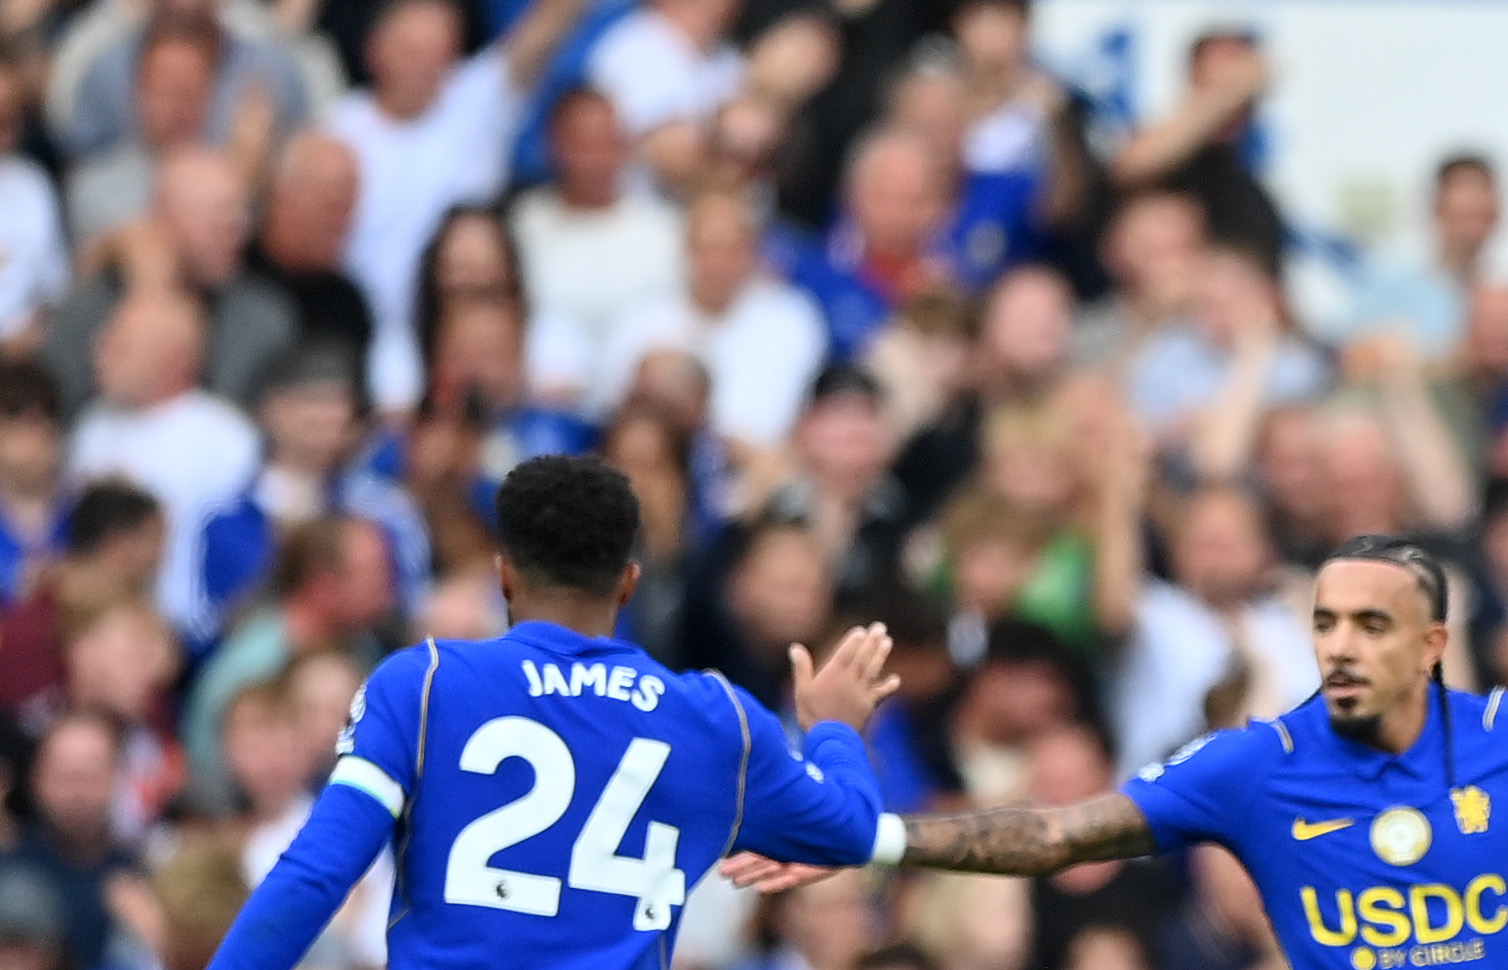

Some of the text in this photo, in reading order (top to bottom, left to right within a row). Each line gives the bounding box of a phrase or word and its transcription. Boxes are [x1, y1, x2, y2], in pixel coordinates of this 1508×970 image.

[521, 659, 665, 712] JAMES
[444, 715, 686, 931] 24
[1379, 937, 1486, 970] BY CIRCLE
